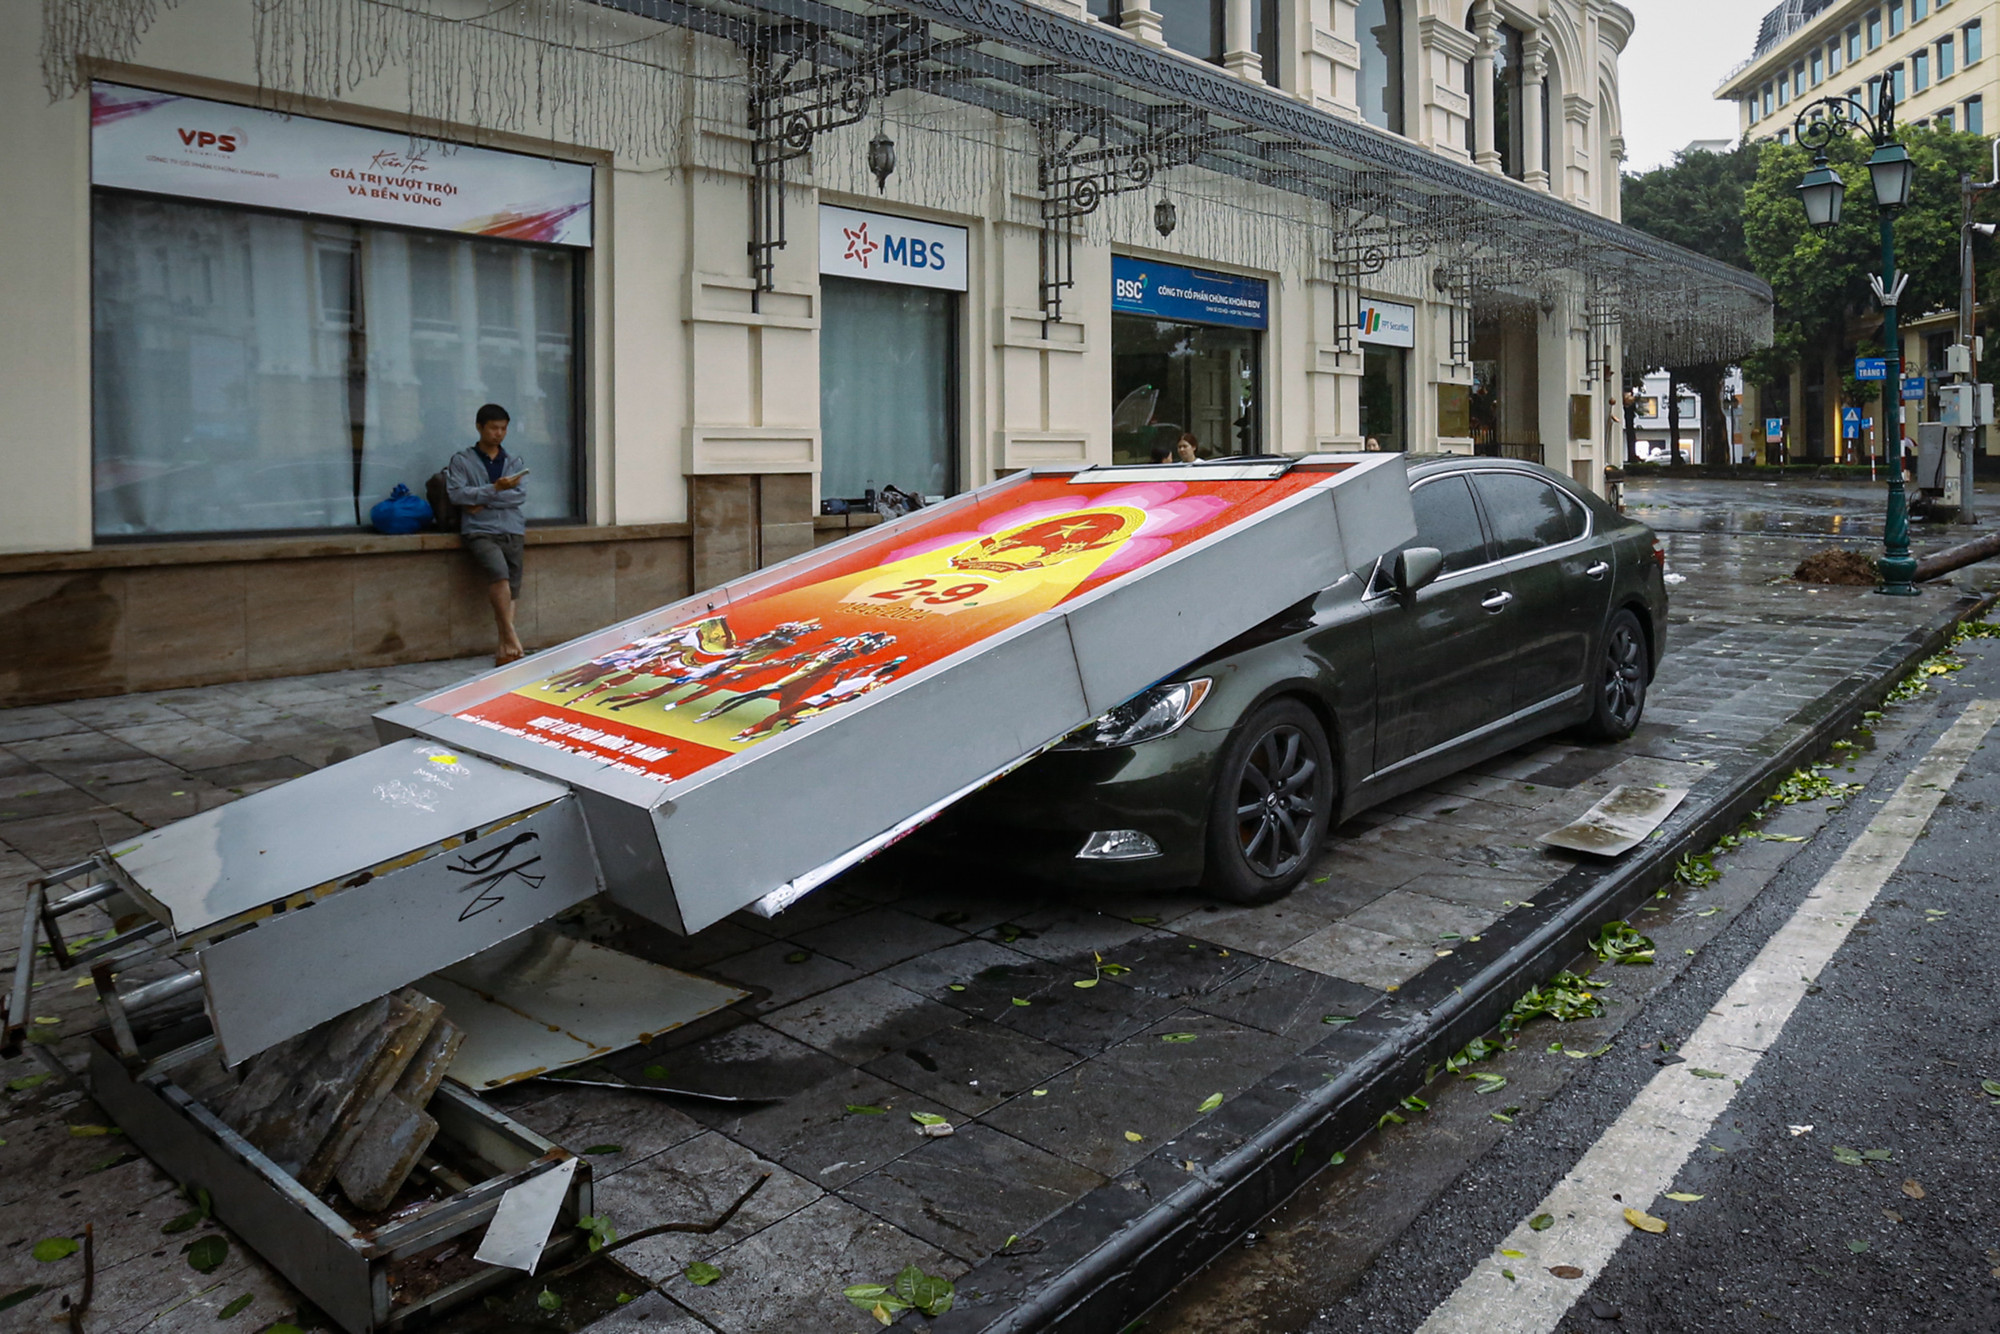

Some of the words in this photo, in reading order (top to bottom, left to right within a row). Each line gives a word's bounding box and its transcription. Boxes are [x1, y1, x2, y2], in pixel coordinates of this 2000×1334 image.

[178, 128, 236, 152] VPS
[330, 167, 356, 181] GIÁ
[359, 172, 381, 186] TRỊ
[385, 176, 423, 190] VƯỢT
[426, 182, 457, 196] TRỘI
[348, 184, 368, 197] VÀ
[371, 186, 399, 201] BỀN
[402, 192, 442, 207] VỮNG
[883, 234, 945, 271] MBS
[1117, 279, 1143, 299] BSC
[1158, 285, 1176, 297] CÔNG
[1176, 289, 1184, 298] TY
[1228, 295, 1247, 307] KHOÁN
[1248, 299, 1261, 309] BIDV
[869, 579, 988, 604] 2-9
[835, 602, 932, 622] 1945-2024
[619, 742, 647, 754] 79
